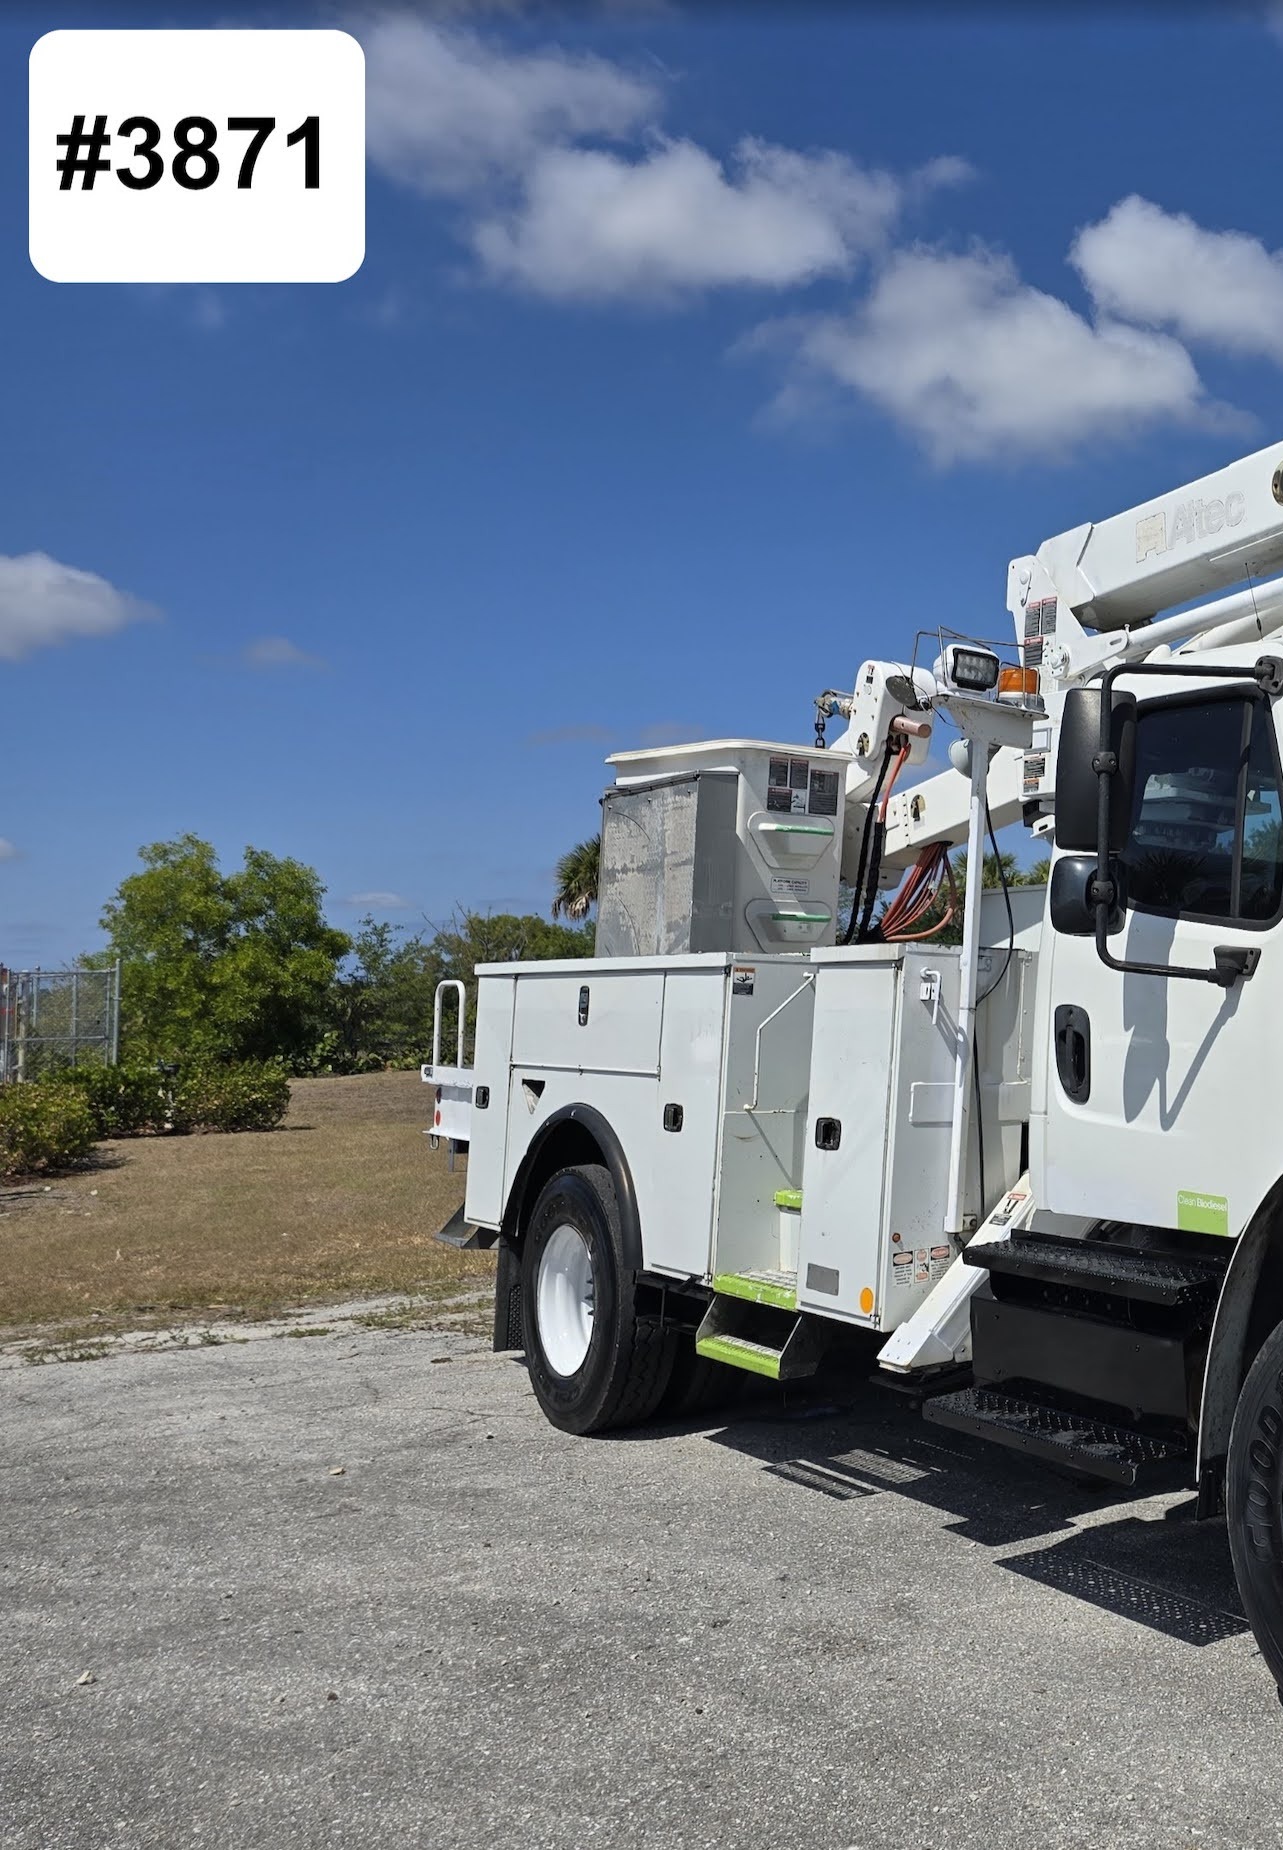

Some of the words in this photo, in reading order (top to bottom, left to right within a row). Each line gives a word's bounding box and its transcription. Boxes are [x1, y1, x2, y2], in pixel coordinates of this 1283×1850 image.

[1167, 490, 1246, 550] Altec
[1178, 1195, 1196, 1206] Clean
[1197, 1198, 1227, 1212] Biodiesel
